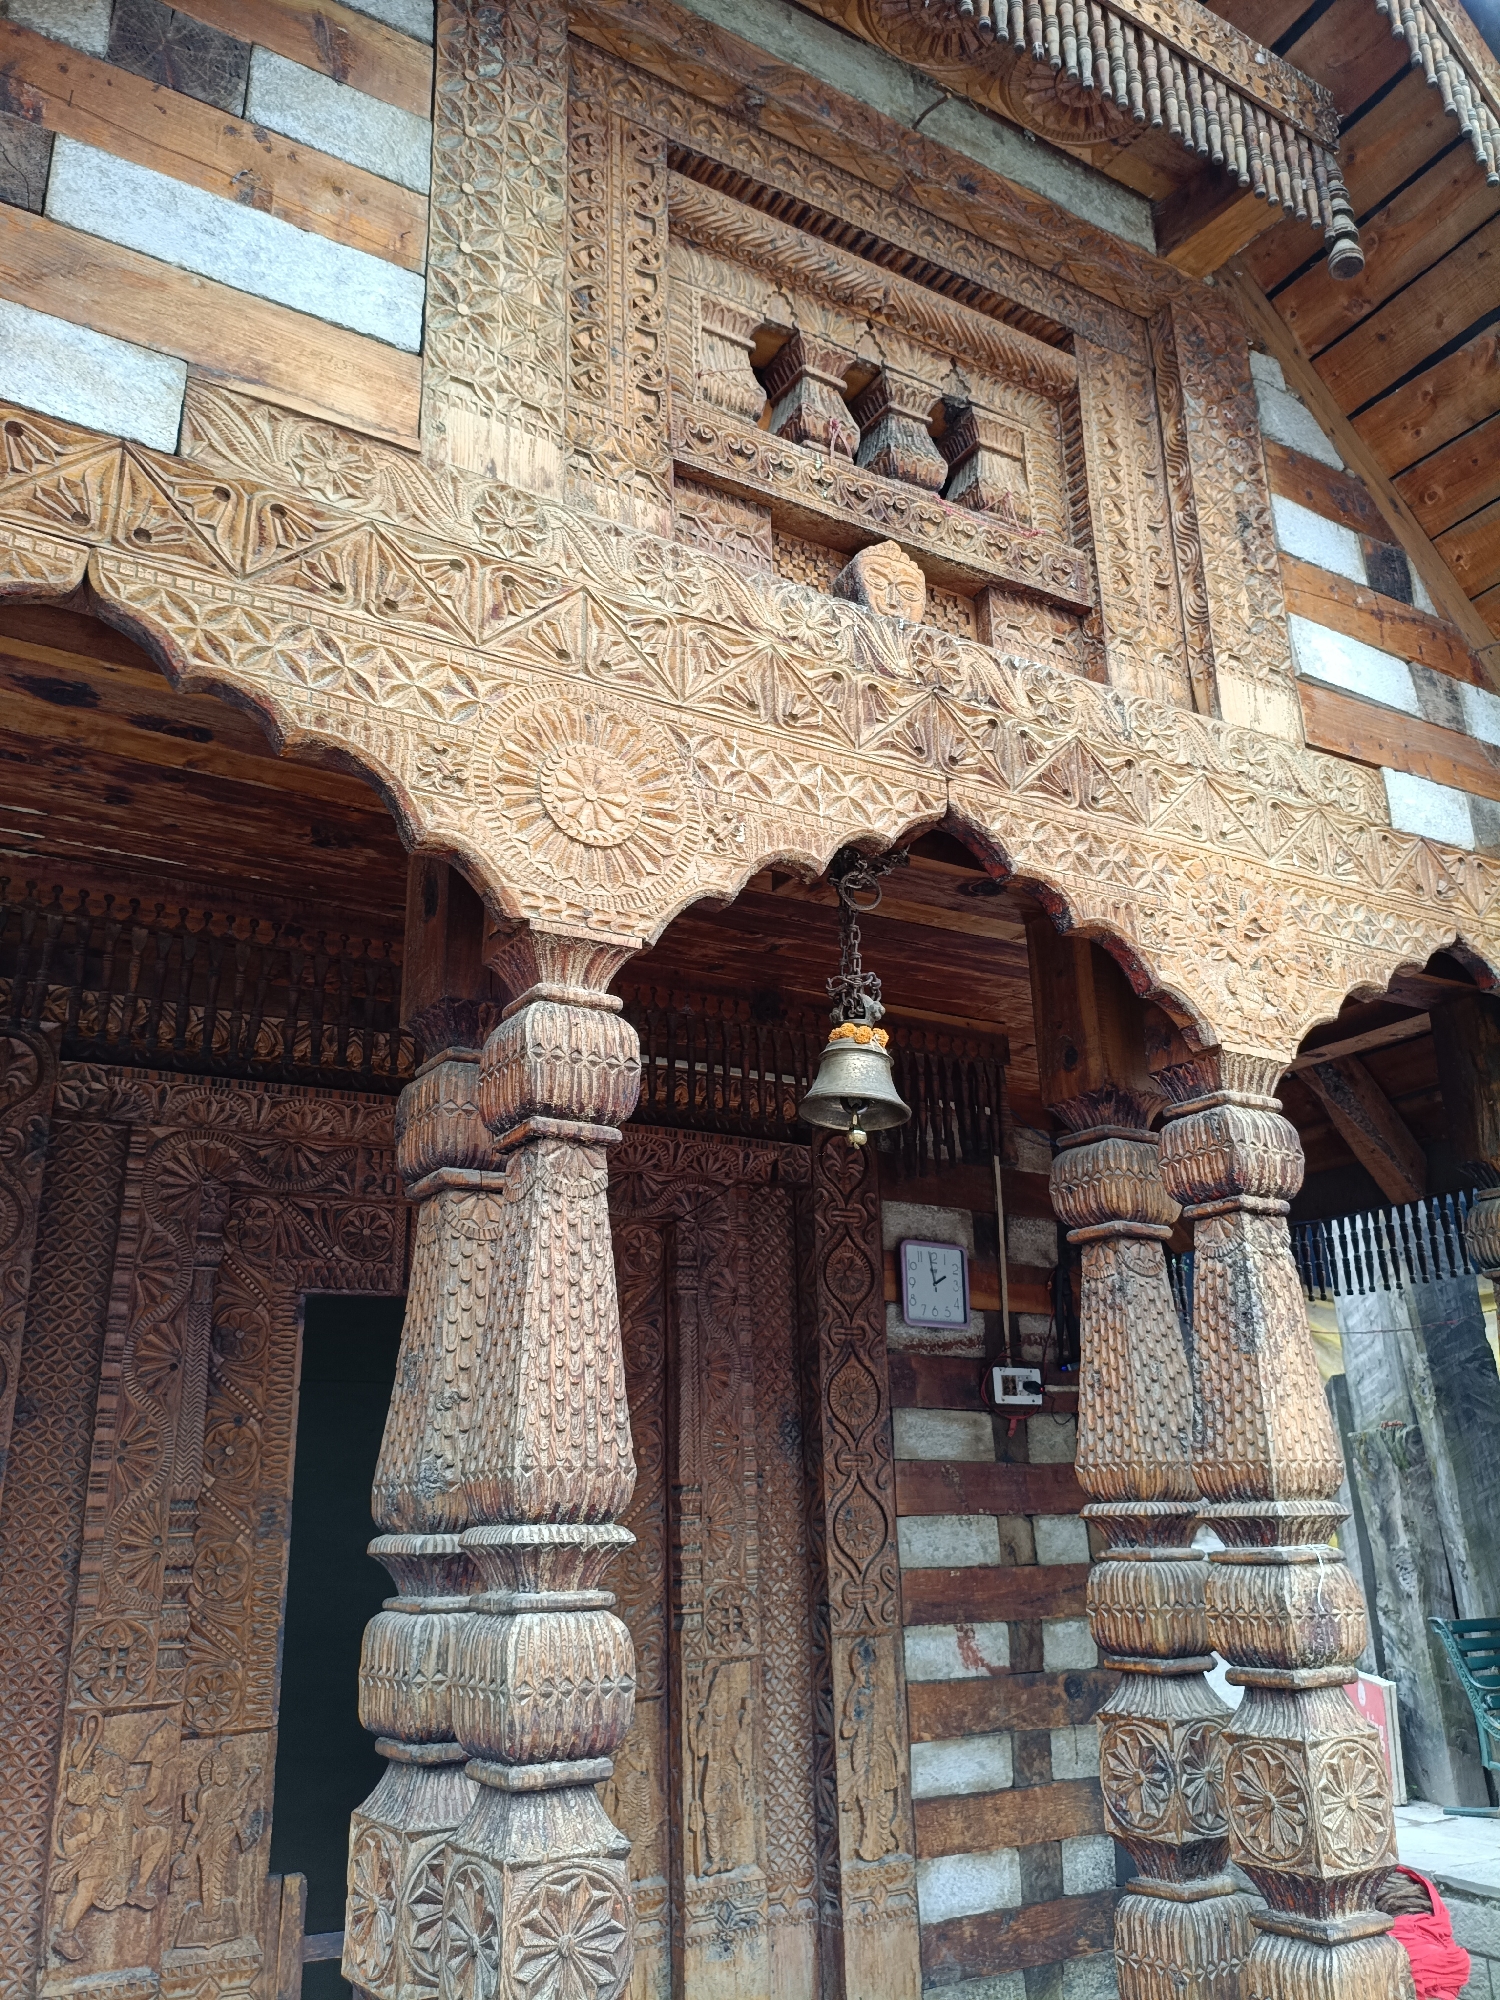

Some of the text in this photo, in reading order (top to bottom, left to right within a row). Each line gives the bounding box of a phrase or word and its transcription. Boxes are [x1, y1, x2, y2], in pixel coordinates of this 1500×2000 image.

[917, 1250, 923, 1263] 11
[908, 1258, 918, 1271] 10
[951, 1263, 959, 1276] 2
[908, 1276, 916, 1289] 9
[952, 1279, 960, 1293] 3
[909, 1293, 917, 1307] 8
[953, 1297, 960, 1310] 4
[920, 1303, 927, 1316] 7
[931, 1305, 939, 1317] 6
[944, 1306, 952, 1318] 5
